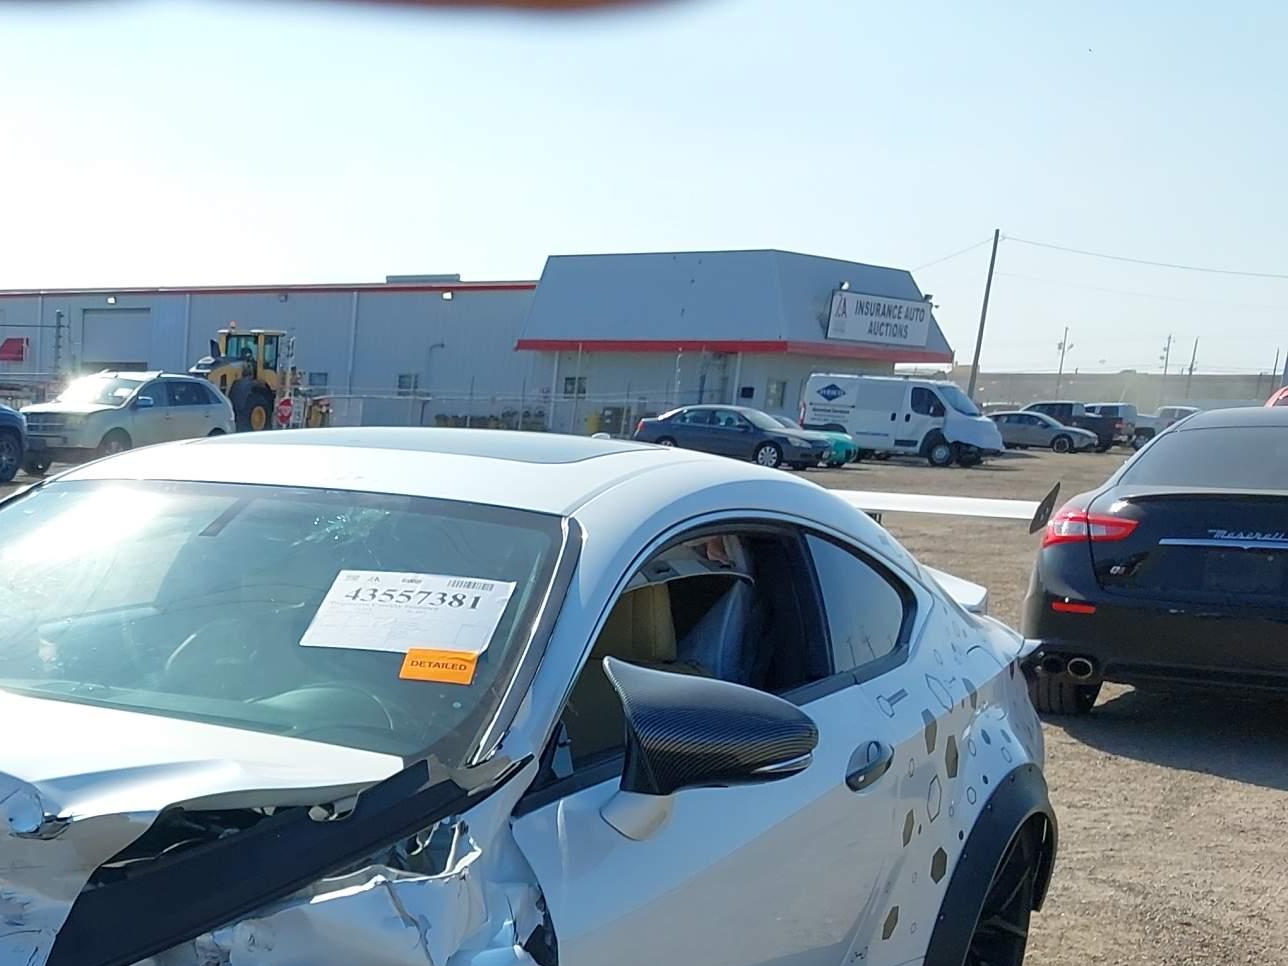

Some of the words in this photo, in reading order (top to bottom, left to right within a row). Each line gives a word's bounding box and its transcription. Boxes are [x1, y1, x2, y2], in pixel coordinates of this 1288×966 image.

[854, 299, 902, 320] INSURANCE
[904, 305, 926, 322] AUTO
[867, 320, 909, 339] AUCTIONS
[344, 586, 482, 610] 43557381
[410, 659, 468, 672] DETAILED
